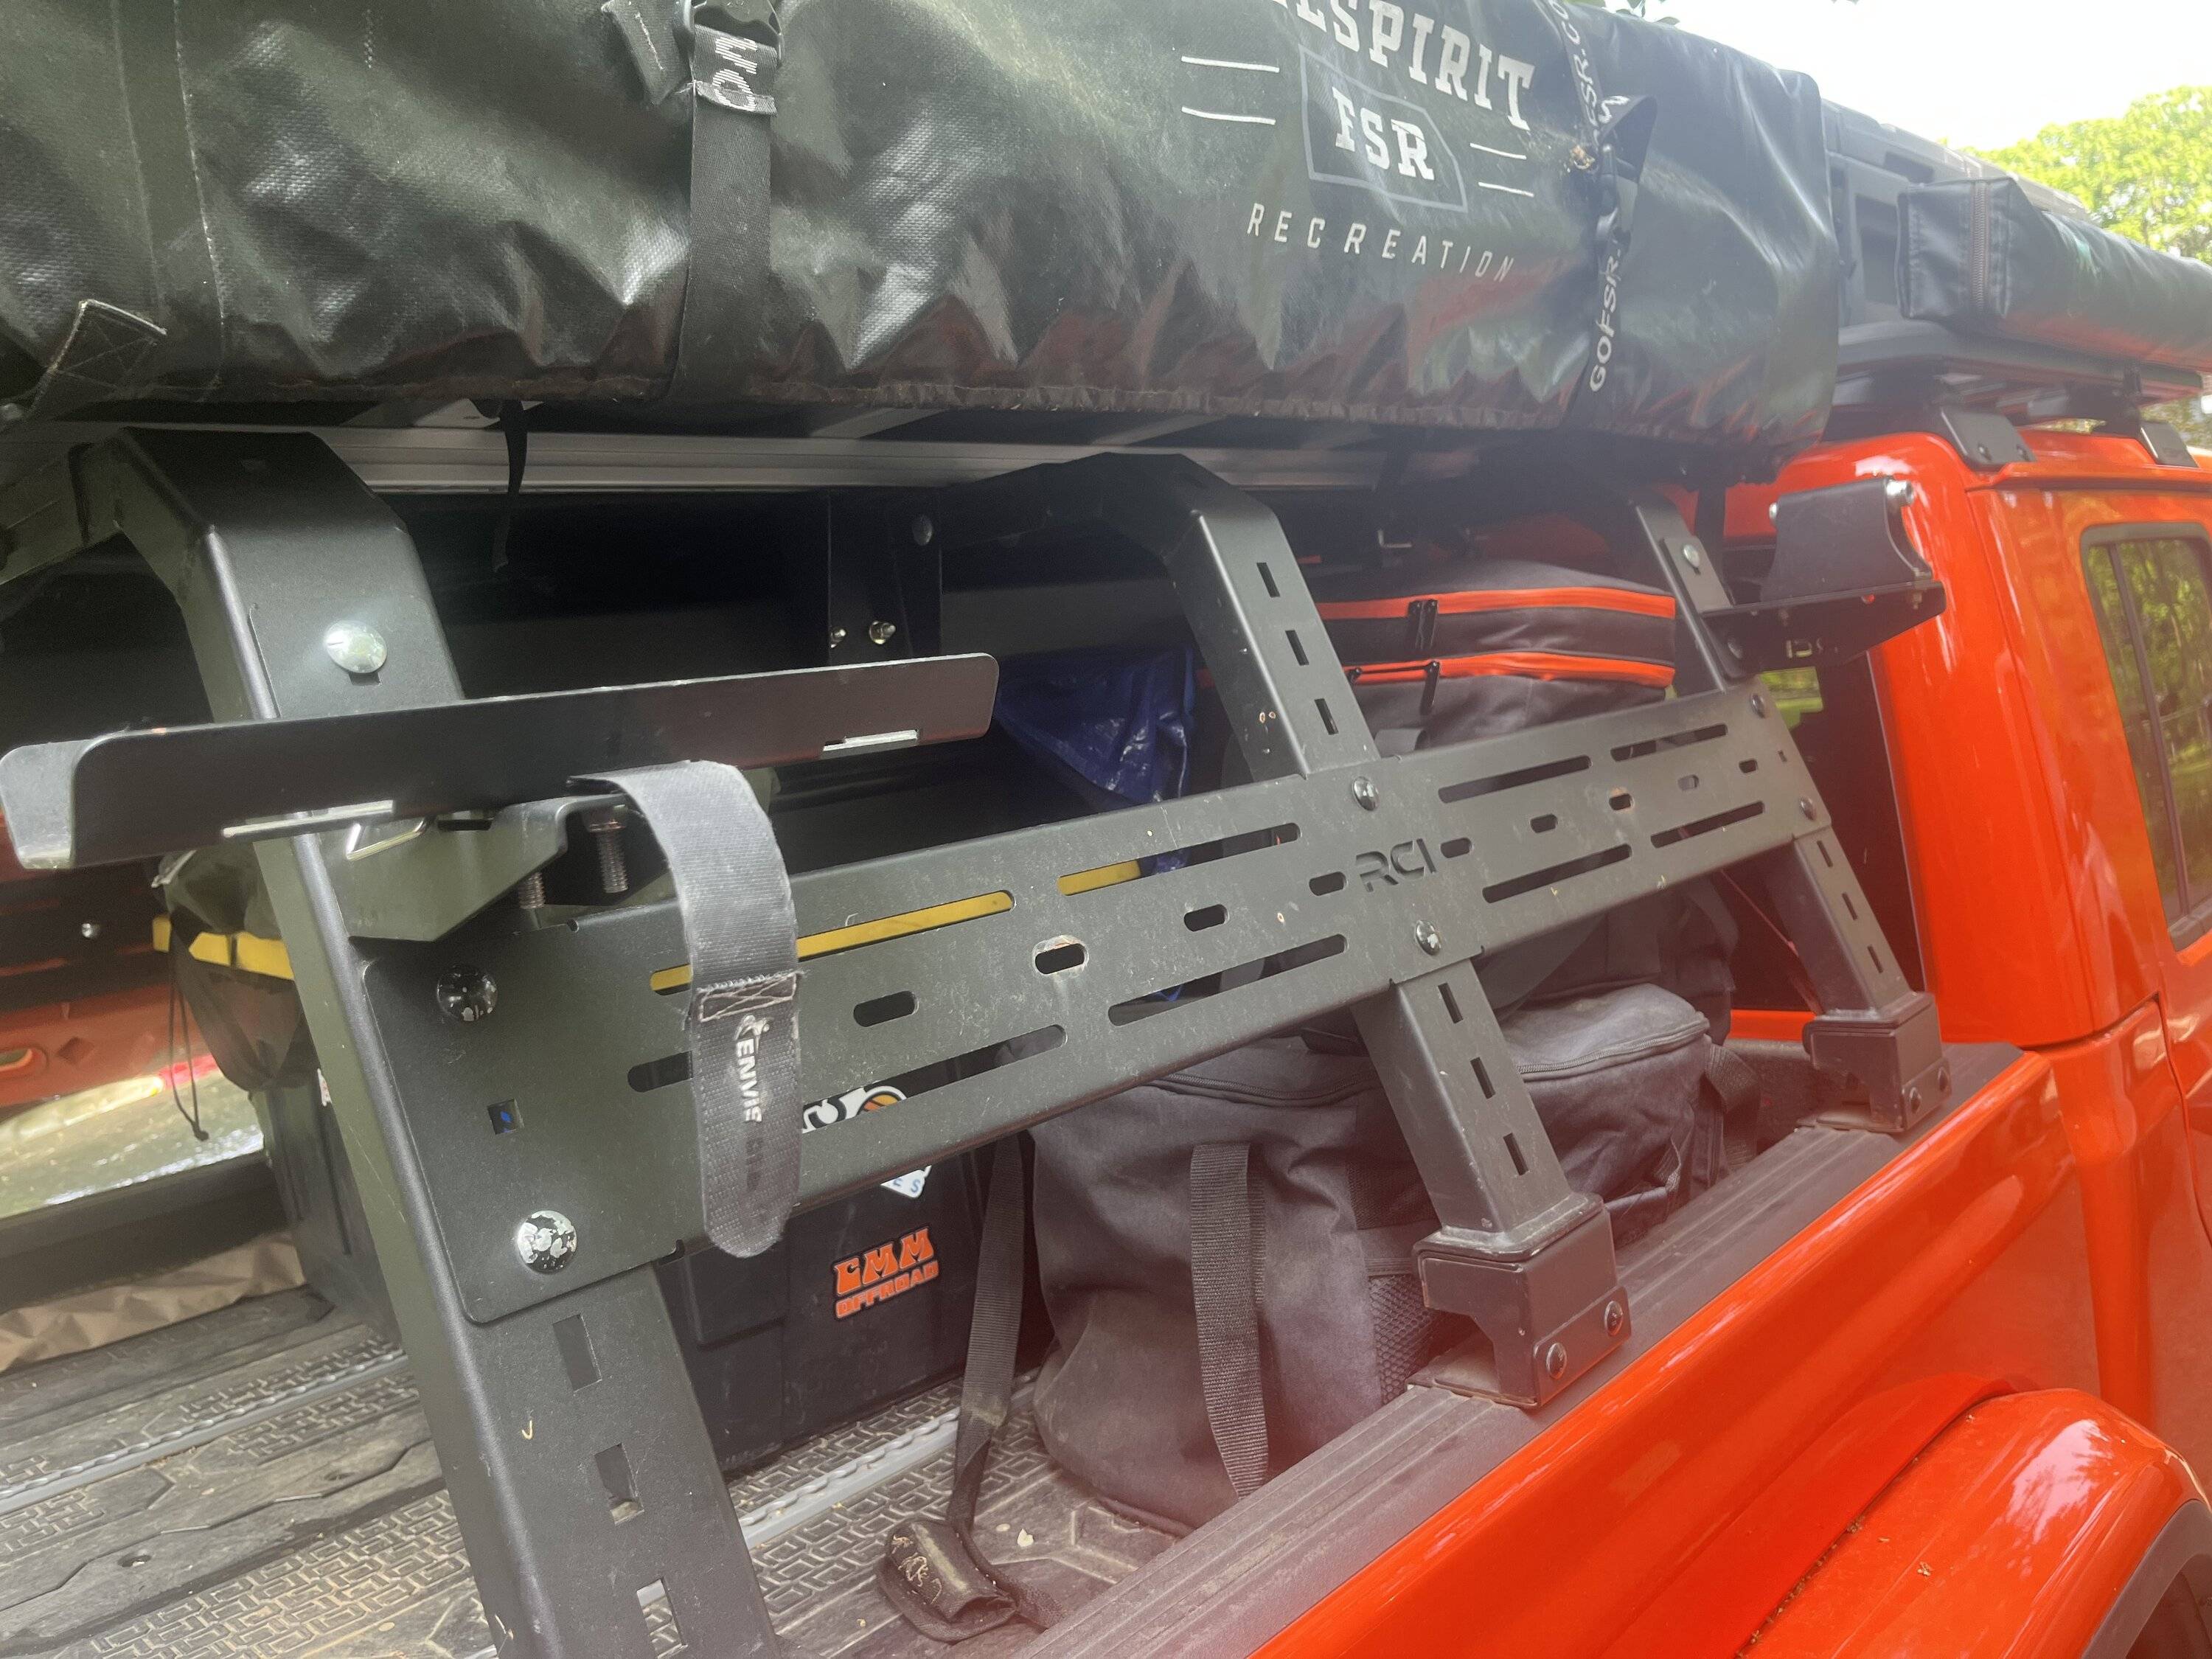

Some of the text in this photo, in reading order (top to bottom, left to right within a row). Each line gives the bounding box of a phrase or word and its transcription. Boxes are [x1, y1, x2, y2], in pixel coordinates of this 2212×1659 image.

[1332, 86, 1435, 181] FSR
[1247, 202, 1514, 283] RECREATION
[1355, 838, 1437, 893] RCI
[835, 1259, 939, 1319] OFFROAD
